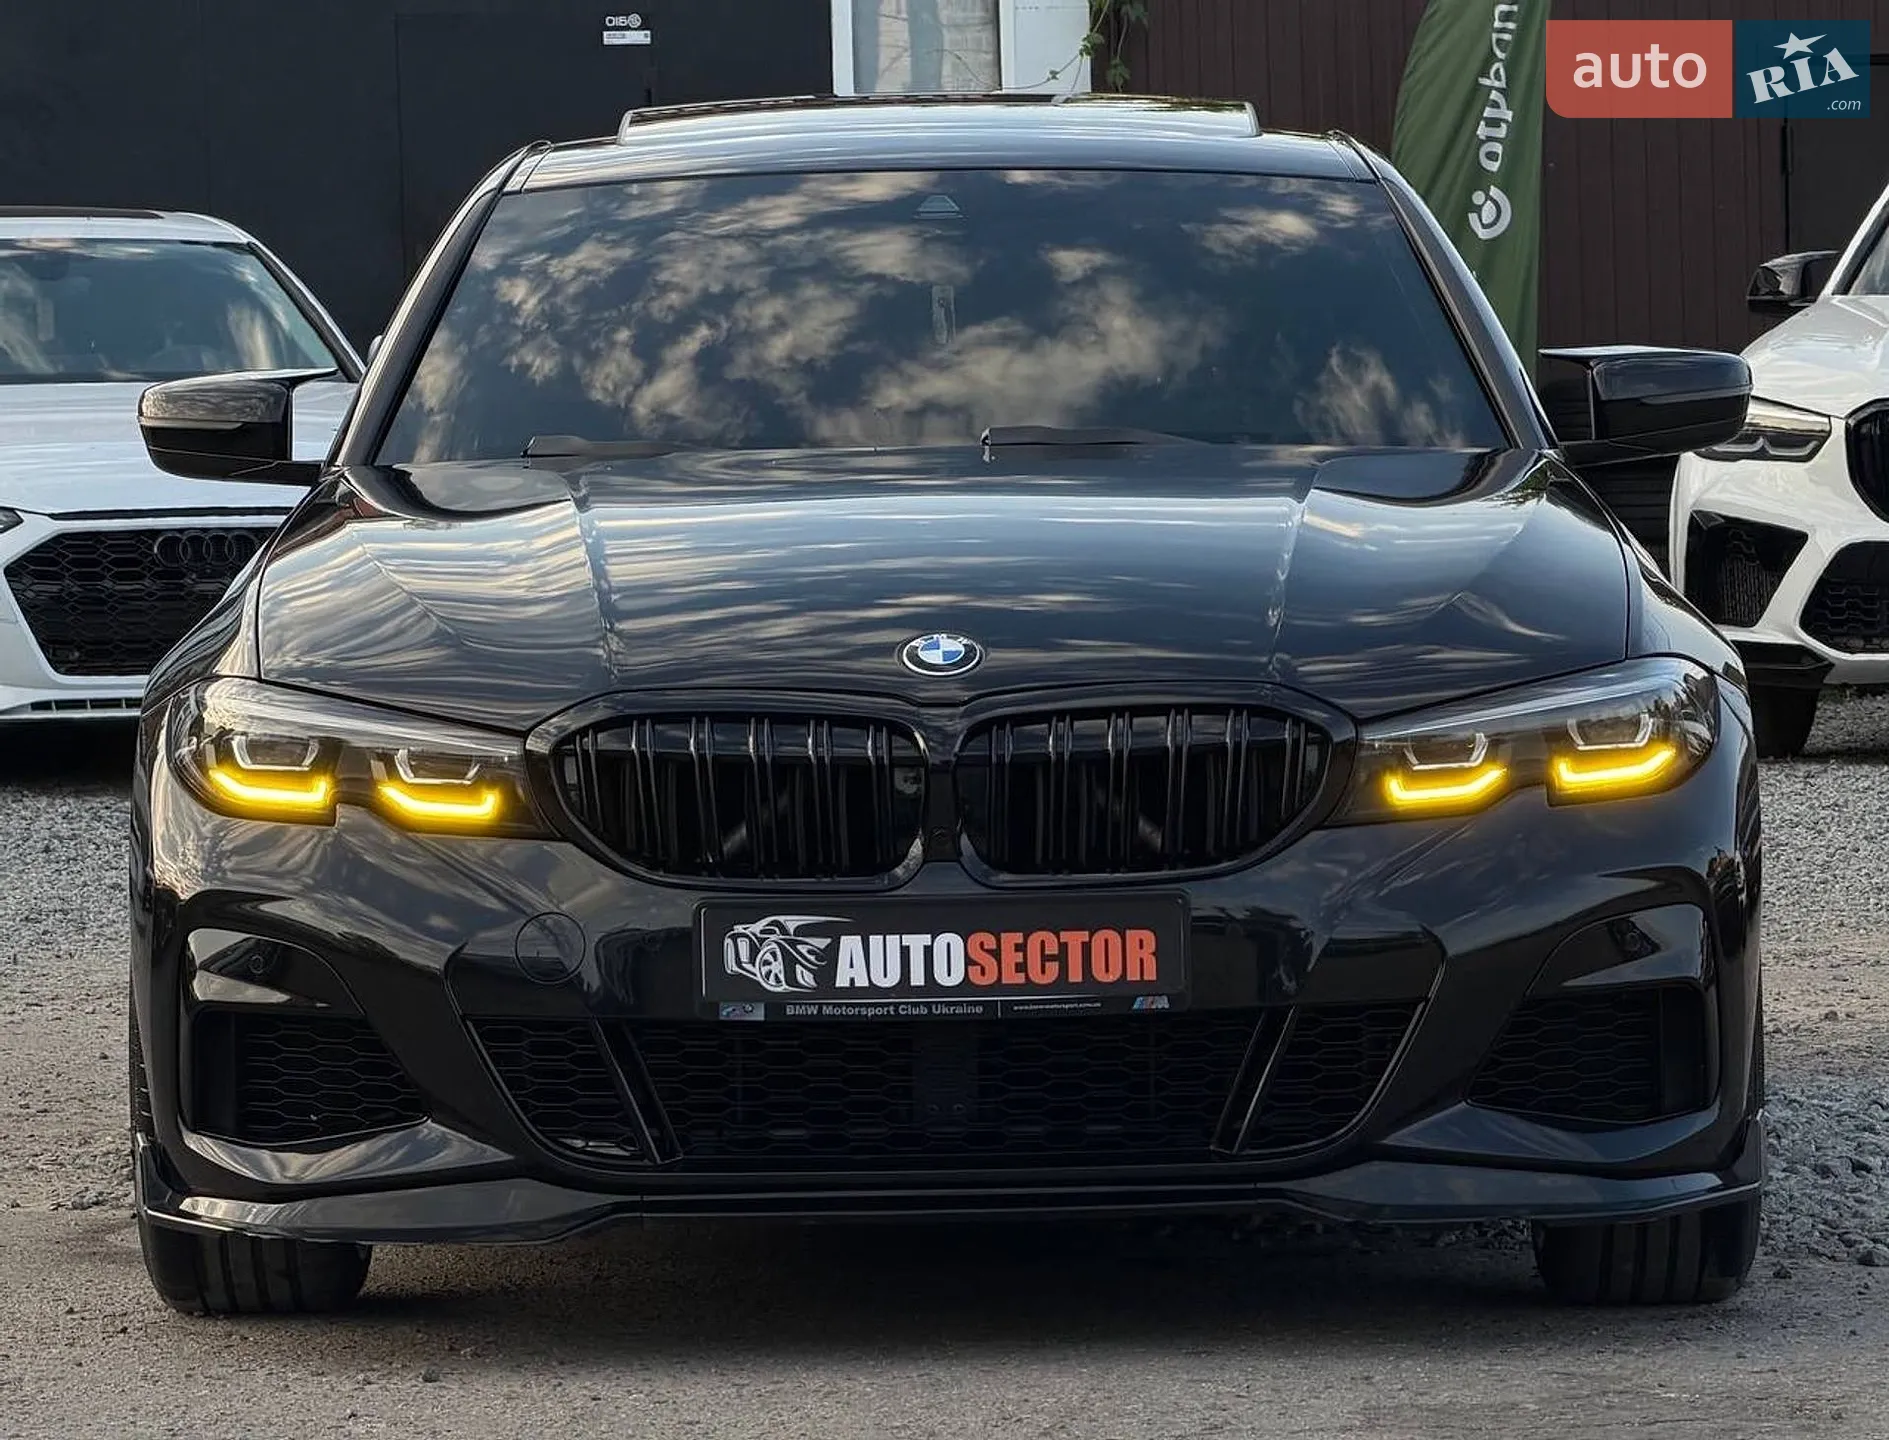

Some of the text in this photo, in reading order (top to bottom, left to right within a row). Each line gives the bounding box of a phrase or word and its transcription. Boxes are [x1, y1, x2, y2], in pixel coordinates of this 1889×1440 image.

[834, 929, 1158, 988] AUTOSECTOR
[786, 1002, 984, 1017] BMW Motorsport Club Ukraine
